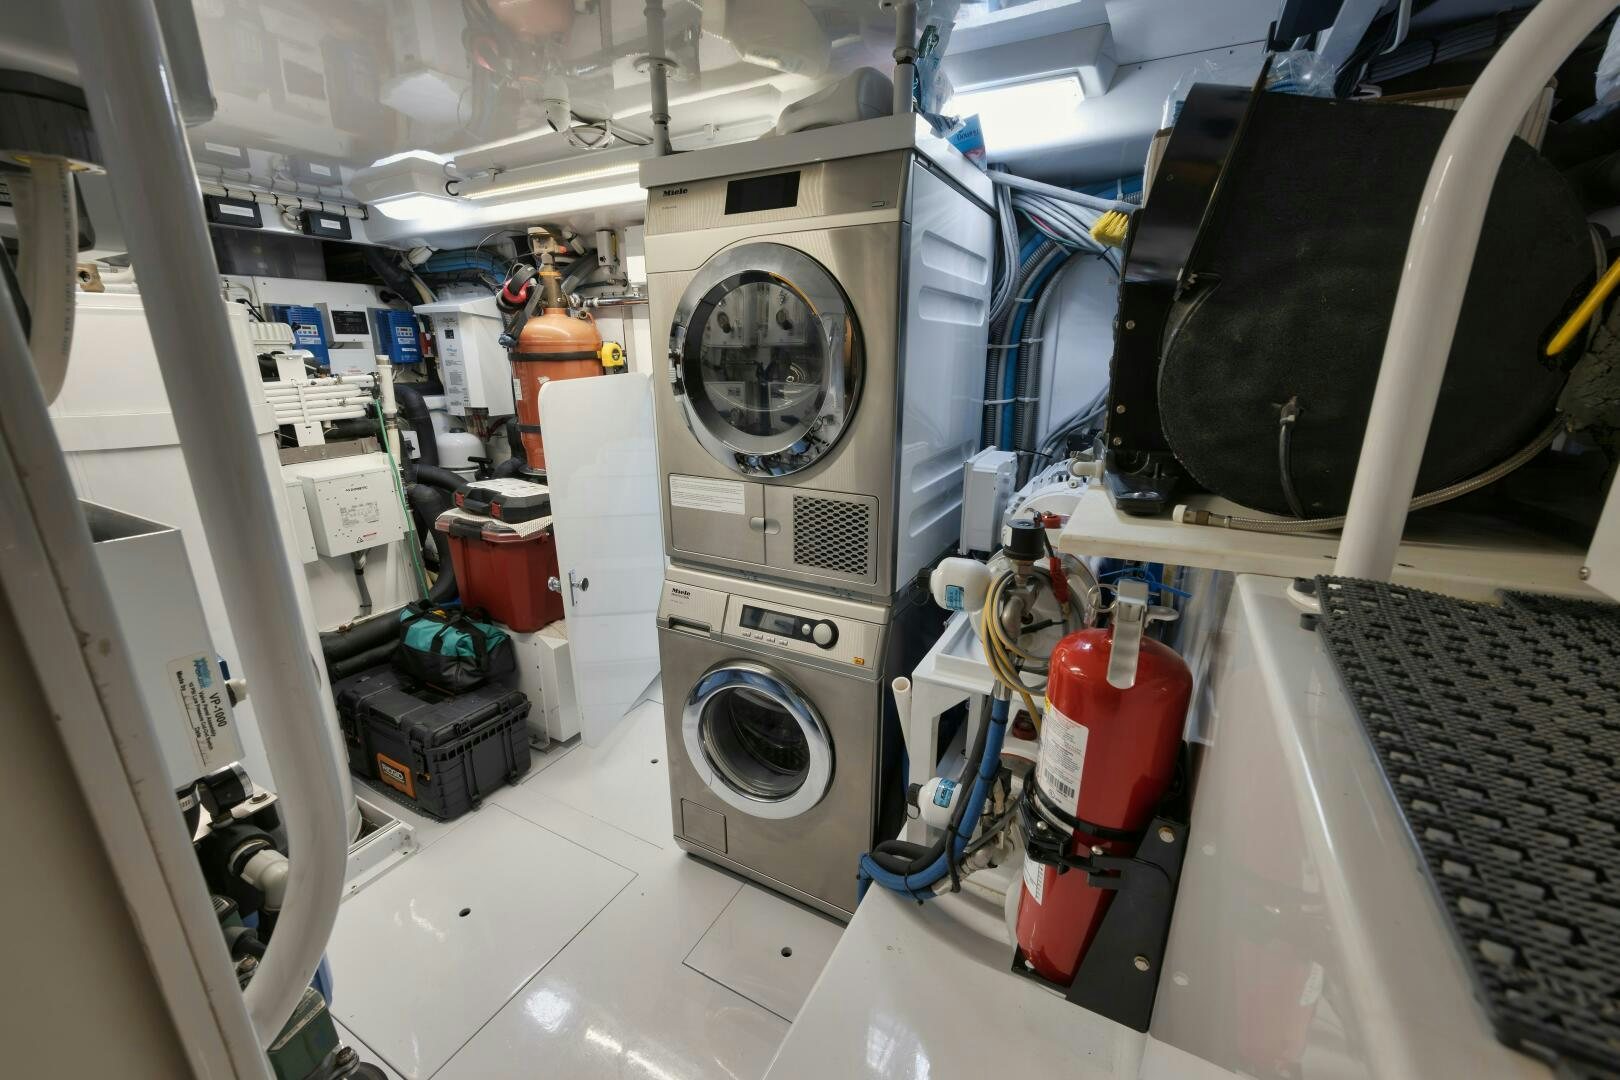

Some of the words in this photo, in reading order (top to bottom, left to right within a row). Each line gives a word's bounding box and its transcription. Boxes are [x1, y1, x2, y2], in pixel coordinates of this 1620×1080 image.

[663, 188, 688, 196] Miele
[671, 587, 691, 596] Miele
[198, 691, 206, 703] Valve
[176, 670, 185, 685] Made
[194, 727, 202, 738] Date
[209, 692, 228, 727] VP-1000
